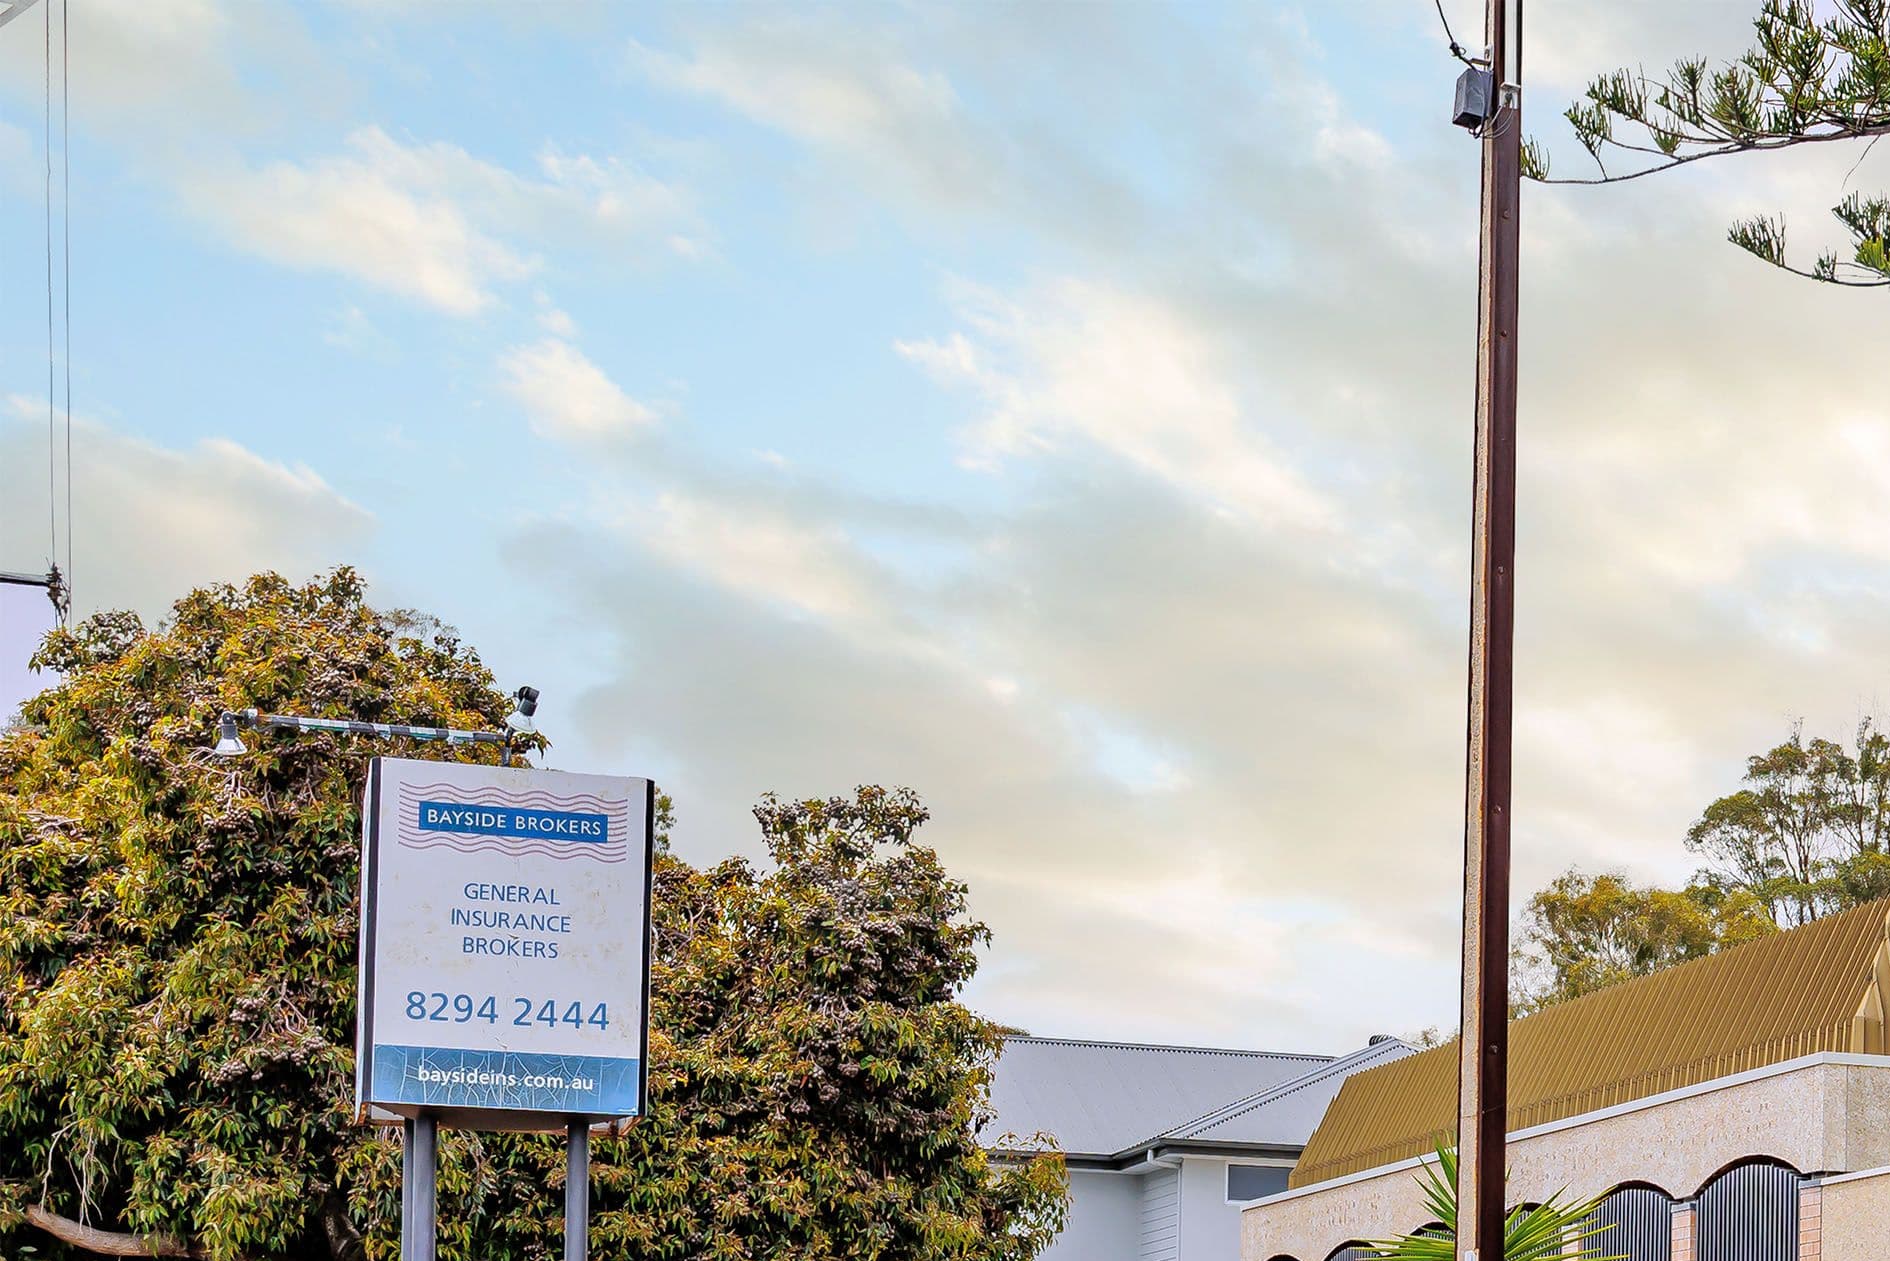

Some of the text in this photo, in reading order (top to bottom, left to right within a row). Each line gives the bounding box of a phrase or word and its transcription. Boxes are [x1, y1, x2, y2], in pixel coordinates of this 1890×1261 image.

[427, 808, 602, 836] BAYSIDE BROKERS
[464, 882, 561, 906] GENERAL
[451, 908, 571, 933] INSURANCE
[462, 937, 558, 959] BROKERS
[405, 991, 610, 1031] 8294 2444
[417, 1064, 593, 1091] baysideins.com.au
